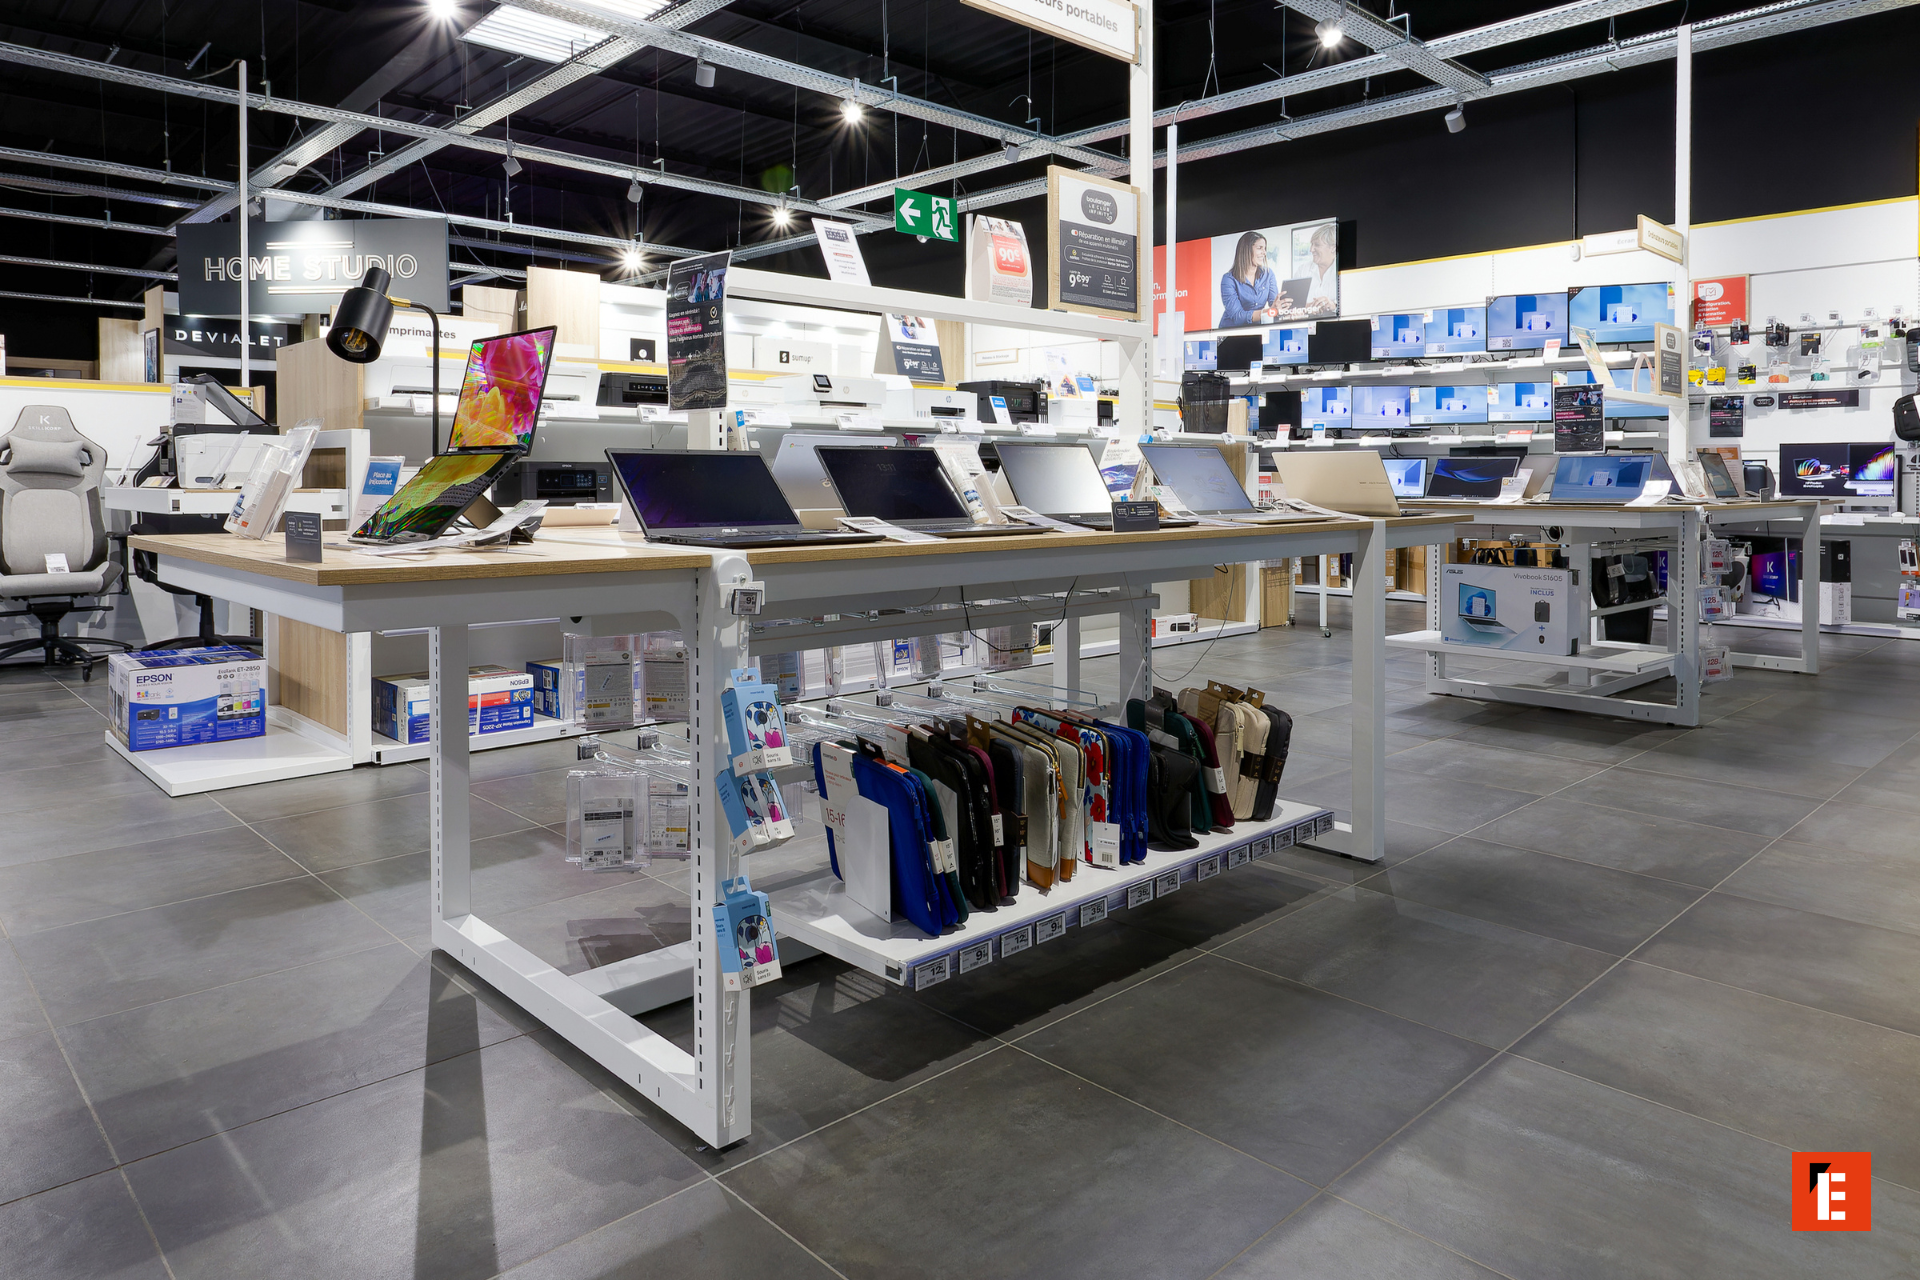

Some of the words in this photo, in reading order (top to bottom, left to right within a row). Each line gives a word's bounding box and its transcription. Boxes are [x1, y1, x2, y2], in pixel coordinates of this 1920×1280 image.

[1066, 3, 1118, 32] portables
[204, 256, 291, 281] HOME
[303, 253, 418, 280] STUDIO
[175, 330, 283, 347] DEVIALET
[389, 326, 456, 339] mprimates
[1513, 573, 1542, 581] Vivobook
[136, 673, 173, 684] EPSON
